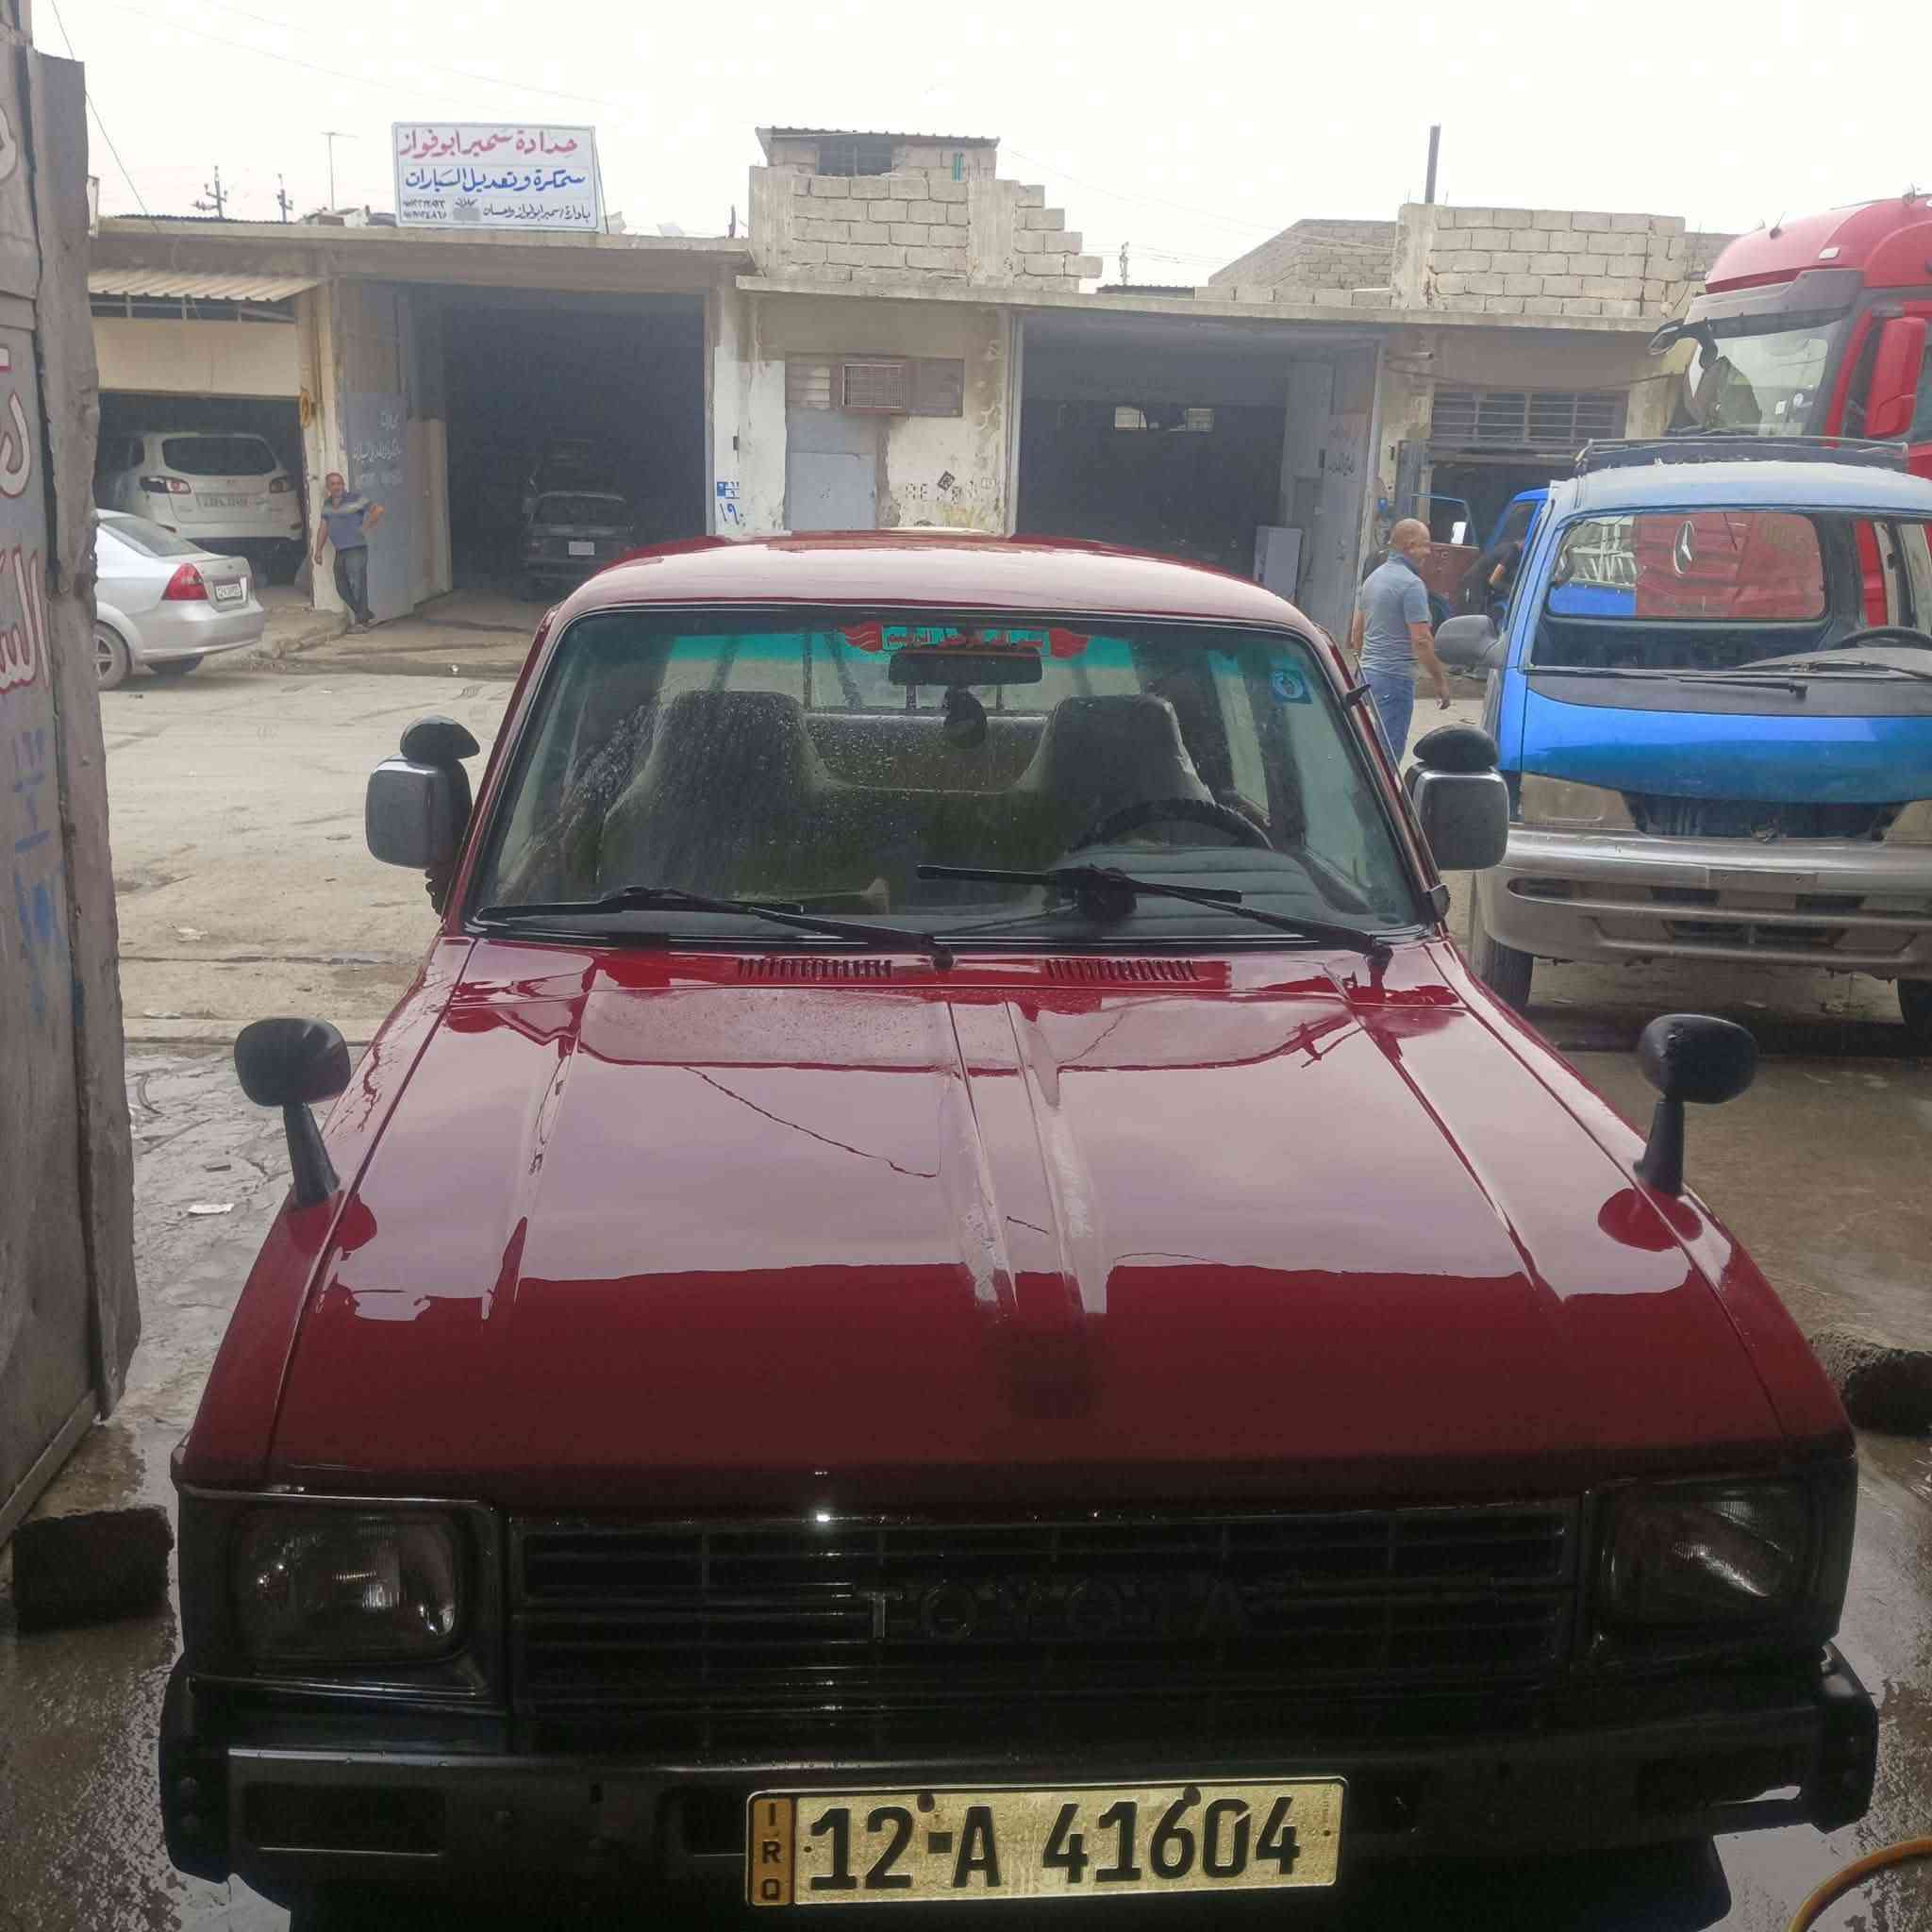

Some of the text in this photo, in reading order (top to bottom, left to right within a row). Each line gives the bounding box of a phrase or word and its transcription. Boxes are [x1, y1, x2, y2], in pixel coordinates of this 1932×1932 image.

[406, 168, 467, 192] السيارات
[534, 169, 586, 192] سمكرة
[1042, 1795, 1302, 1884] 41604
